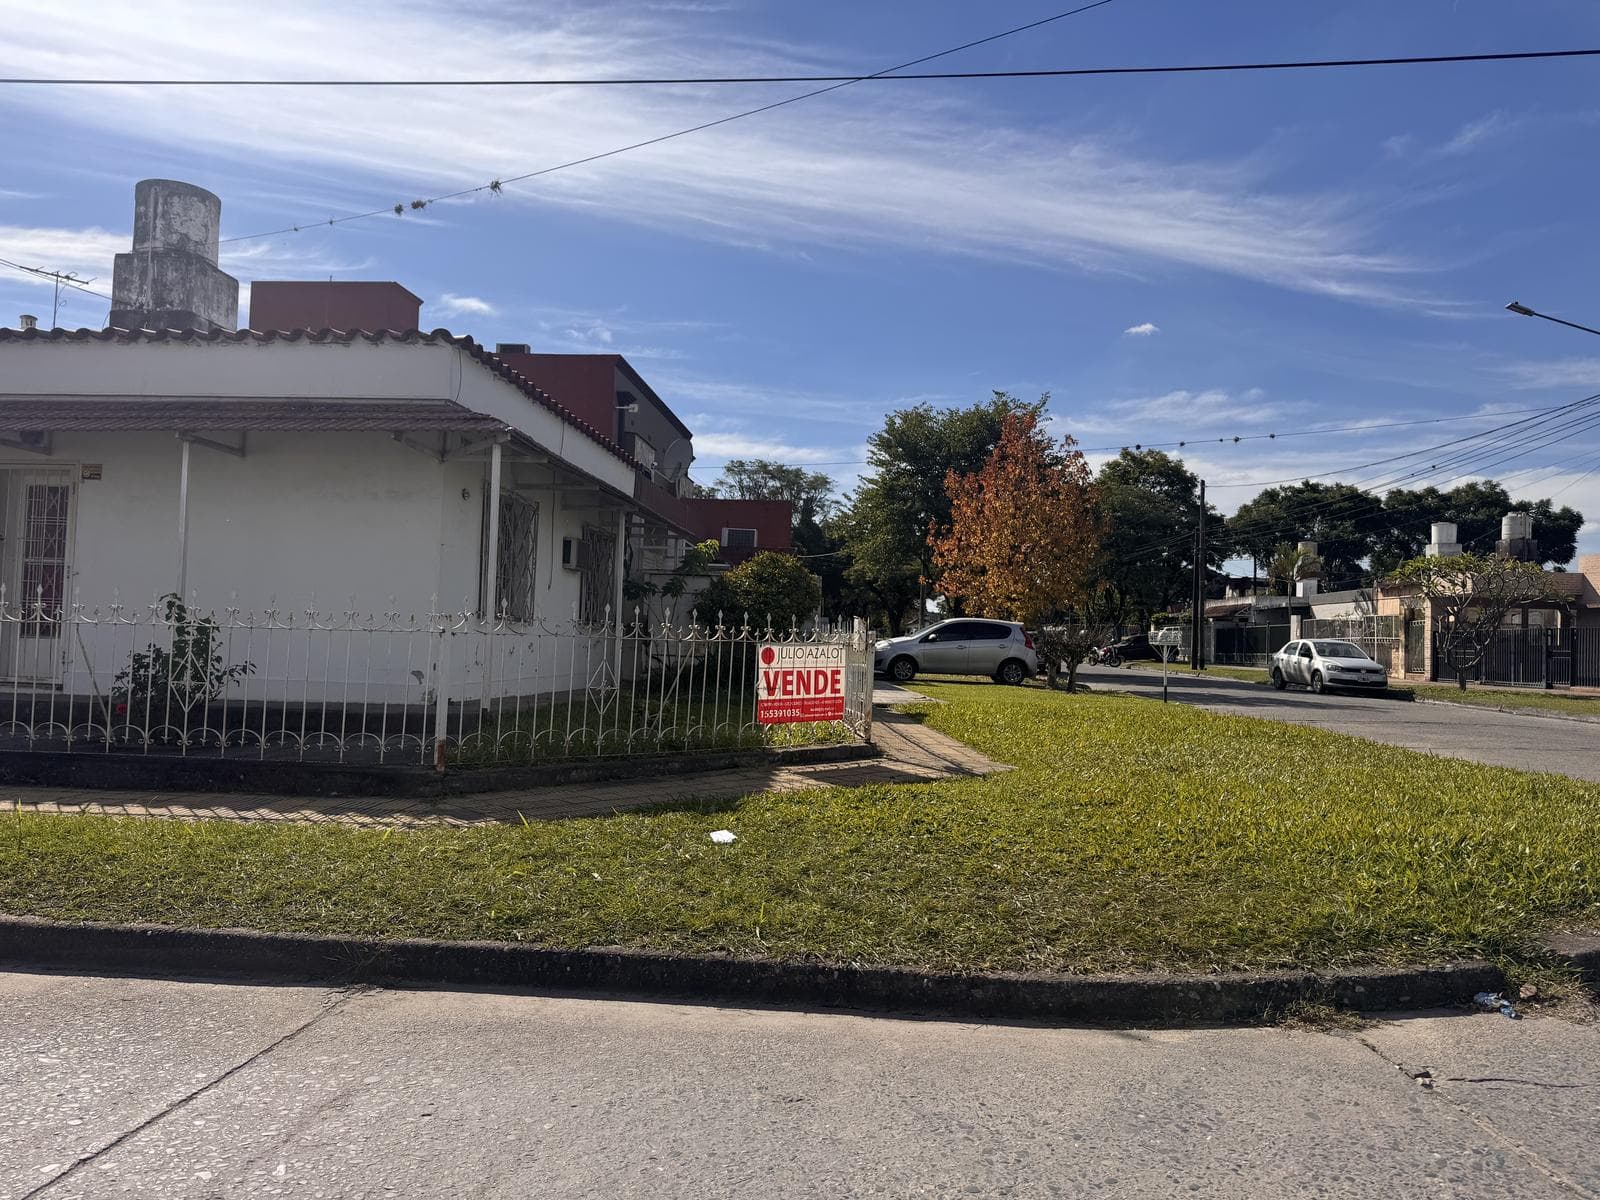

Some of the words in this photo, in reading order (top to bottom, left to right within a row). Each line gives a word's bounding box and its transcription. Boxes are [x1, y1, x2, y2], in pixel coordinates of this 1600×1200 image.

[777, 647, 805, 664] JULIO
[806, 647, 843, 664] AZALOT
[763, 669, 841, 696] VENDE
[760, 708, 800, 718] 155391035
